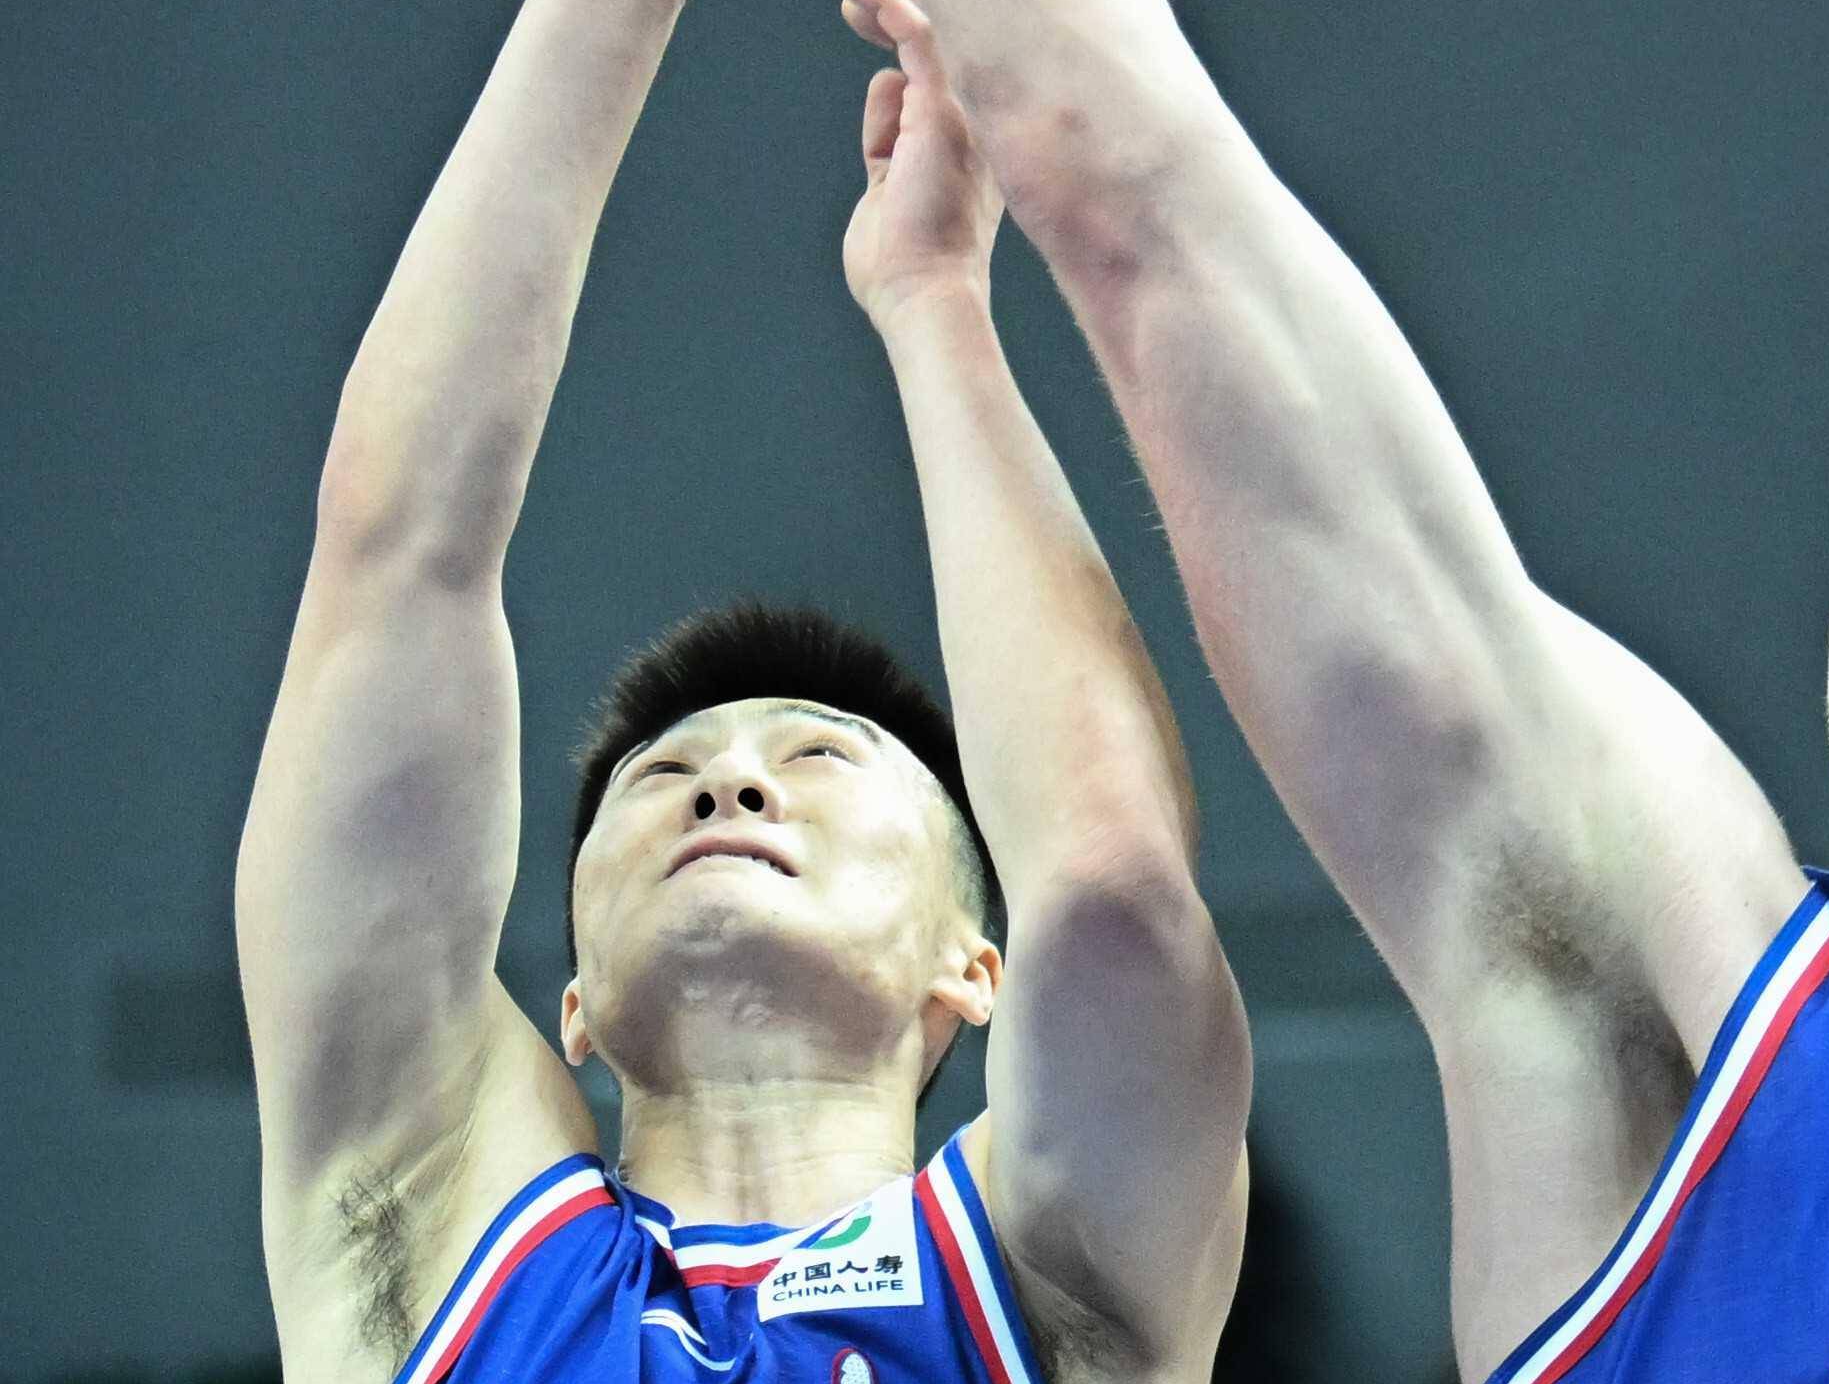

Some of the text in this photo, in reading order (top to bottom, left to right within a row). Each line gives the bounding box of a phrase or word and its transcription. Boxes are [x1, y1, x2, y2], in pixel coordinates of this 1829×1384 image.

[773, 1254, 903, 1287] 中国人寿
[773, 1280, 903, 1301] CHINA LIFE
